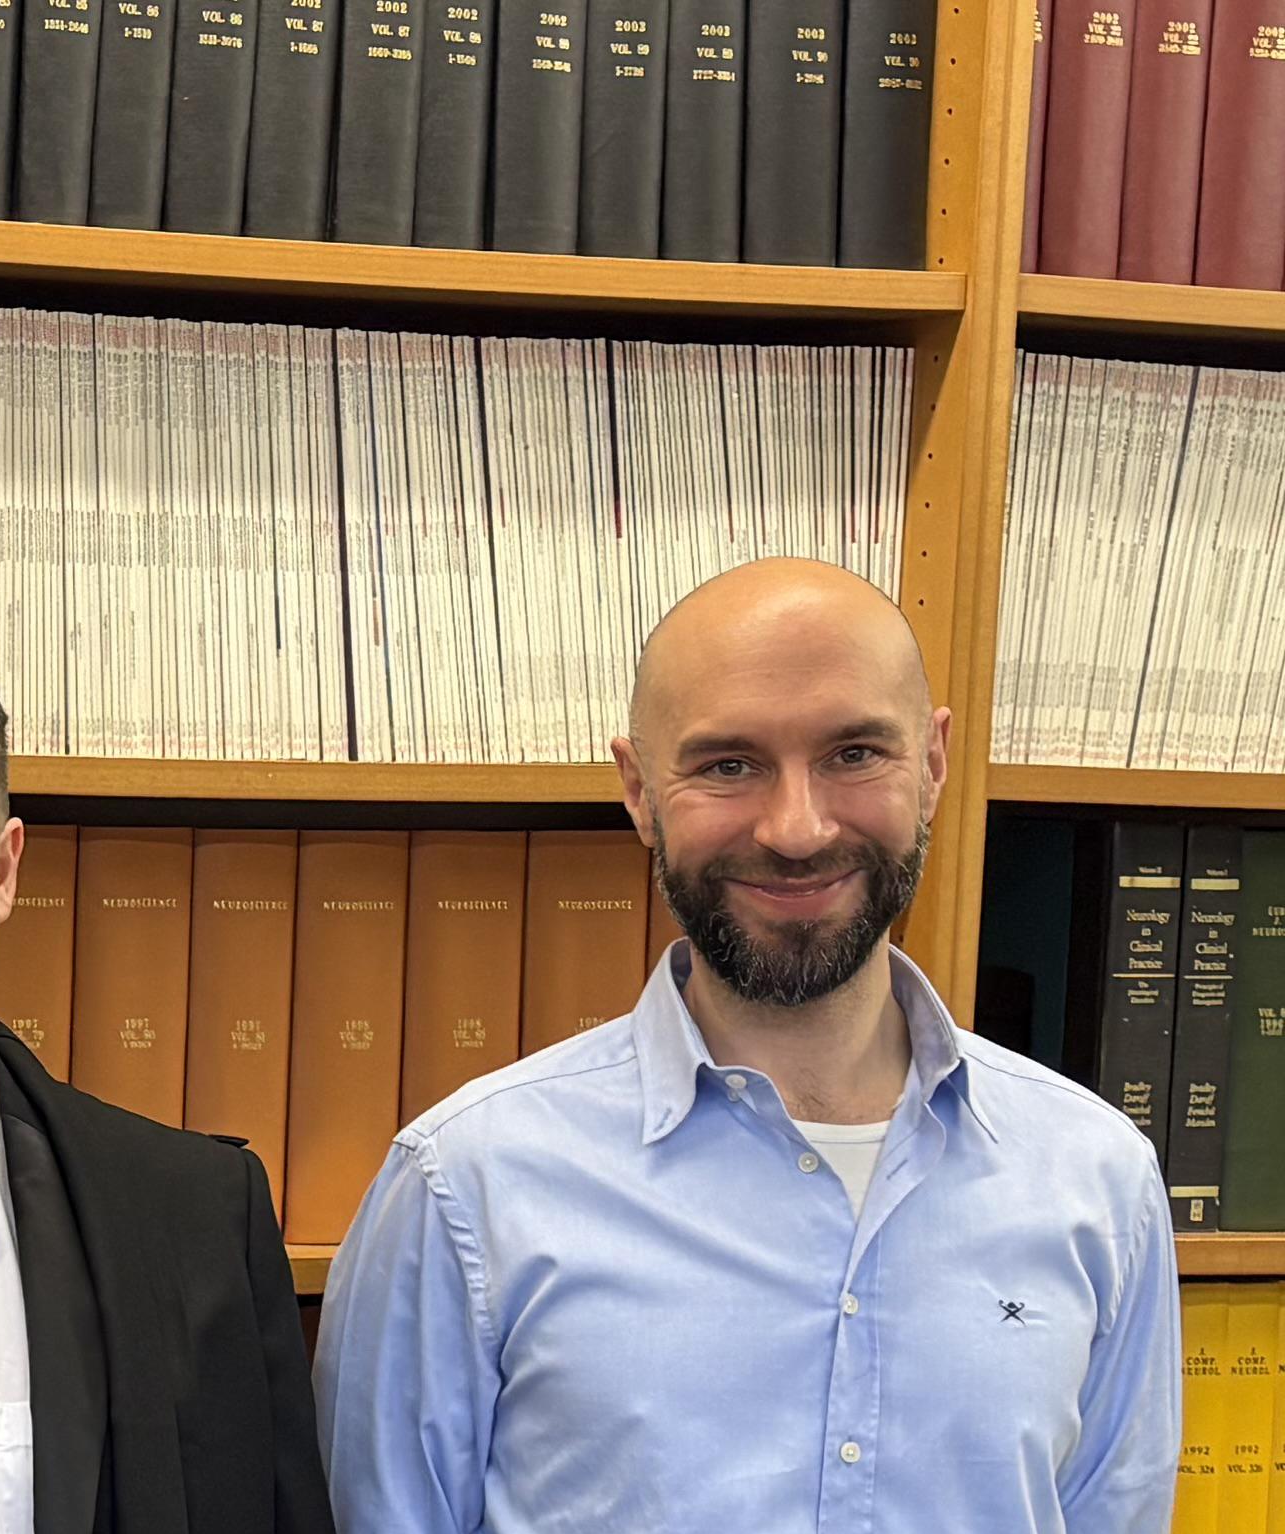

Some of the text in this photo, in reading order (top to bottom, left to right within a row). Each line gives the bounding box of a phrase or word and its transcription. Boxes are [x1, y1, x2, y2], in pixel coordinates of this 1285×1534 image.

[448, 8, 477, 20] 2002
[1126, 910, 1170, 924] Neurology
[1192, 912, 1234, 925] Neurology
[1141, 928, 1151, 936] in
[1209, 930, 1218, 938] in
[1129, 940, 1163, 952] Clinical
[1196, 942, 1227, 954] Clinical
[1129, 957, 1162, 968] Practice
[1194, 960, 1226, 970] Practice
[1184, 1446, 1209, 1456] 1992
